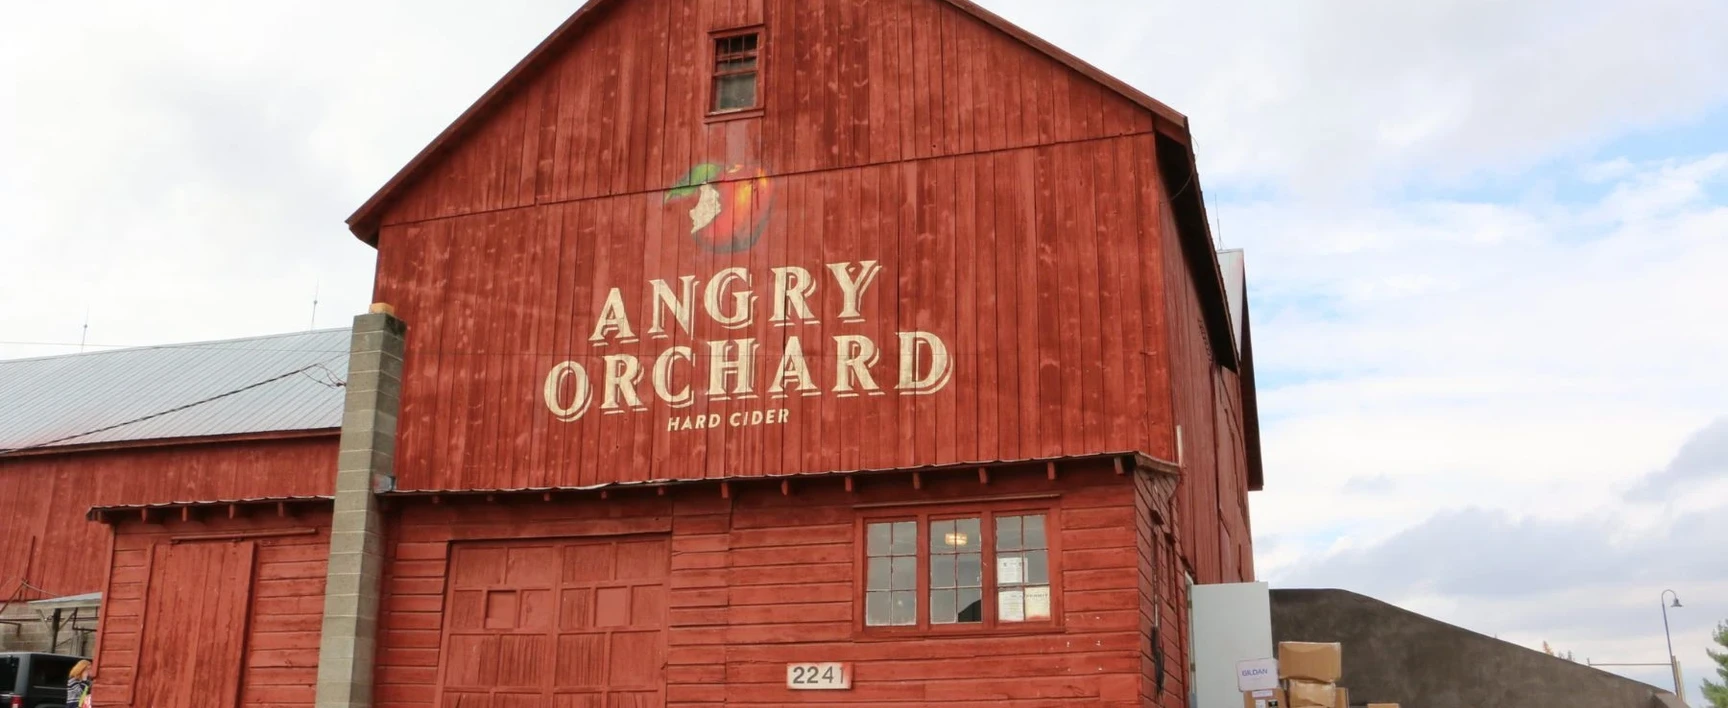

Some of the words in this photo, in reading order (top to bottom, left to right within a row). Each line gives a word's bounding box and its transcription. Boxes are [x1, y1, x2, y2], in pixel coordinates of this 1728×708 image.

[588, 260, 882, 346] ANGRY
[544, 331, 954, 422] ORCHARD
[667, 414, 721, 432] HARD
[729, 408, 789, 427] CIDER
[793, 666, 844, 684] 2241
[1241, 668, 1268, 677] GILDAN
